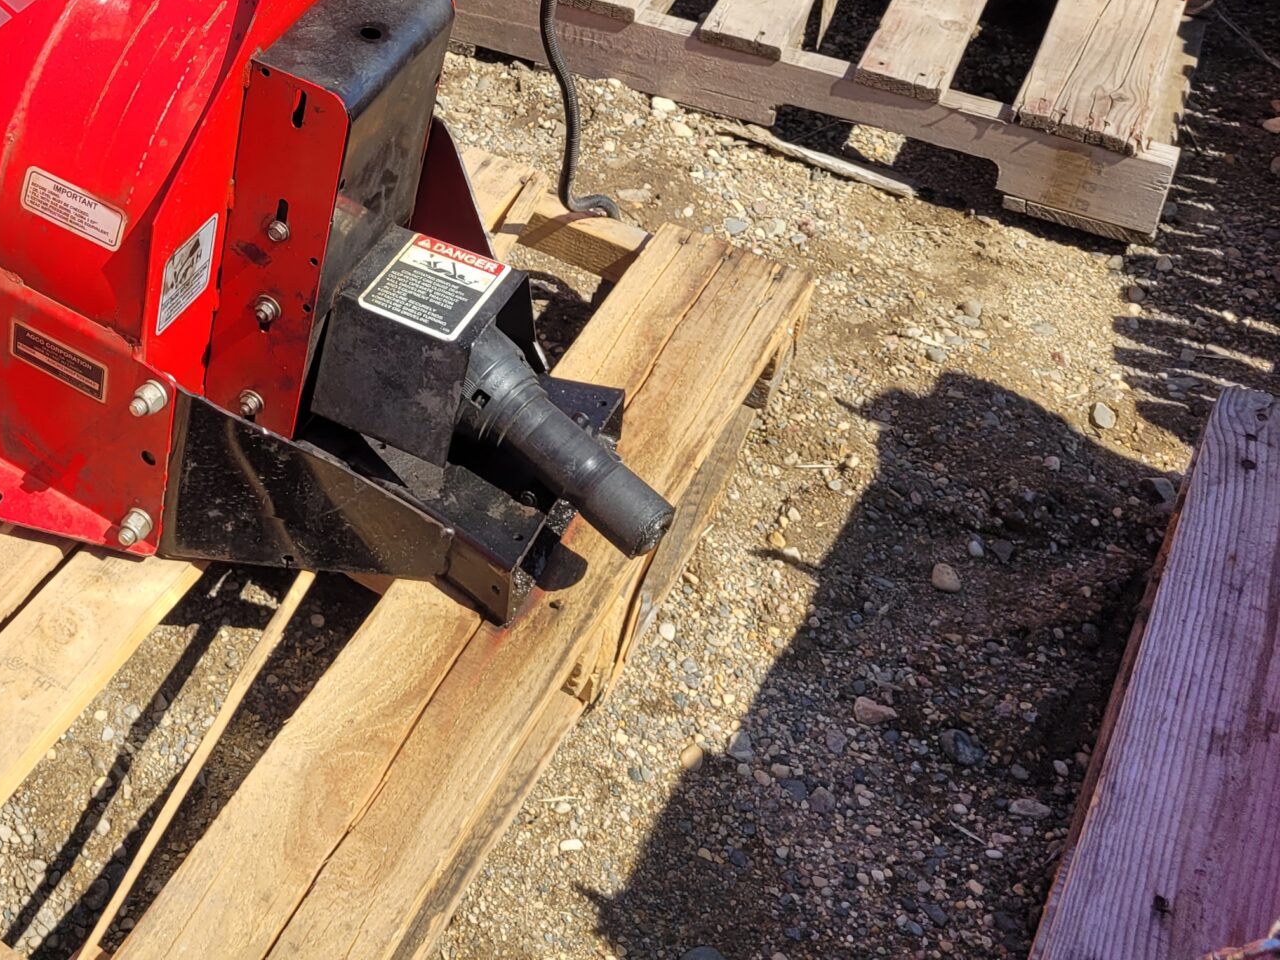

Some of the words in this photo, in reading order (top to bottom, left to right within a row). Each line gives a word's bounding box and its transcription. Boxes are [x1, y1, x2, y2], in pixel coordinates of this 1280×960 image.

[53, 184, 98, 211] IMPORTANT
[433, 242, 498, 273] DANGER
[25, 332, 44, 345] AGCO
[45, 342, 92, 370] CORPORATION
